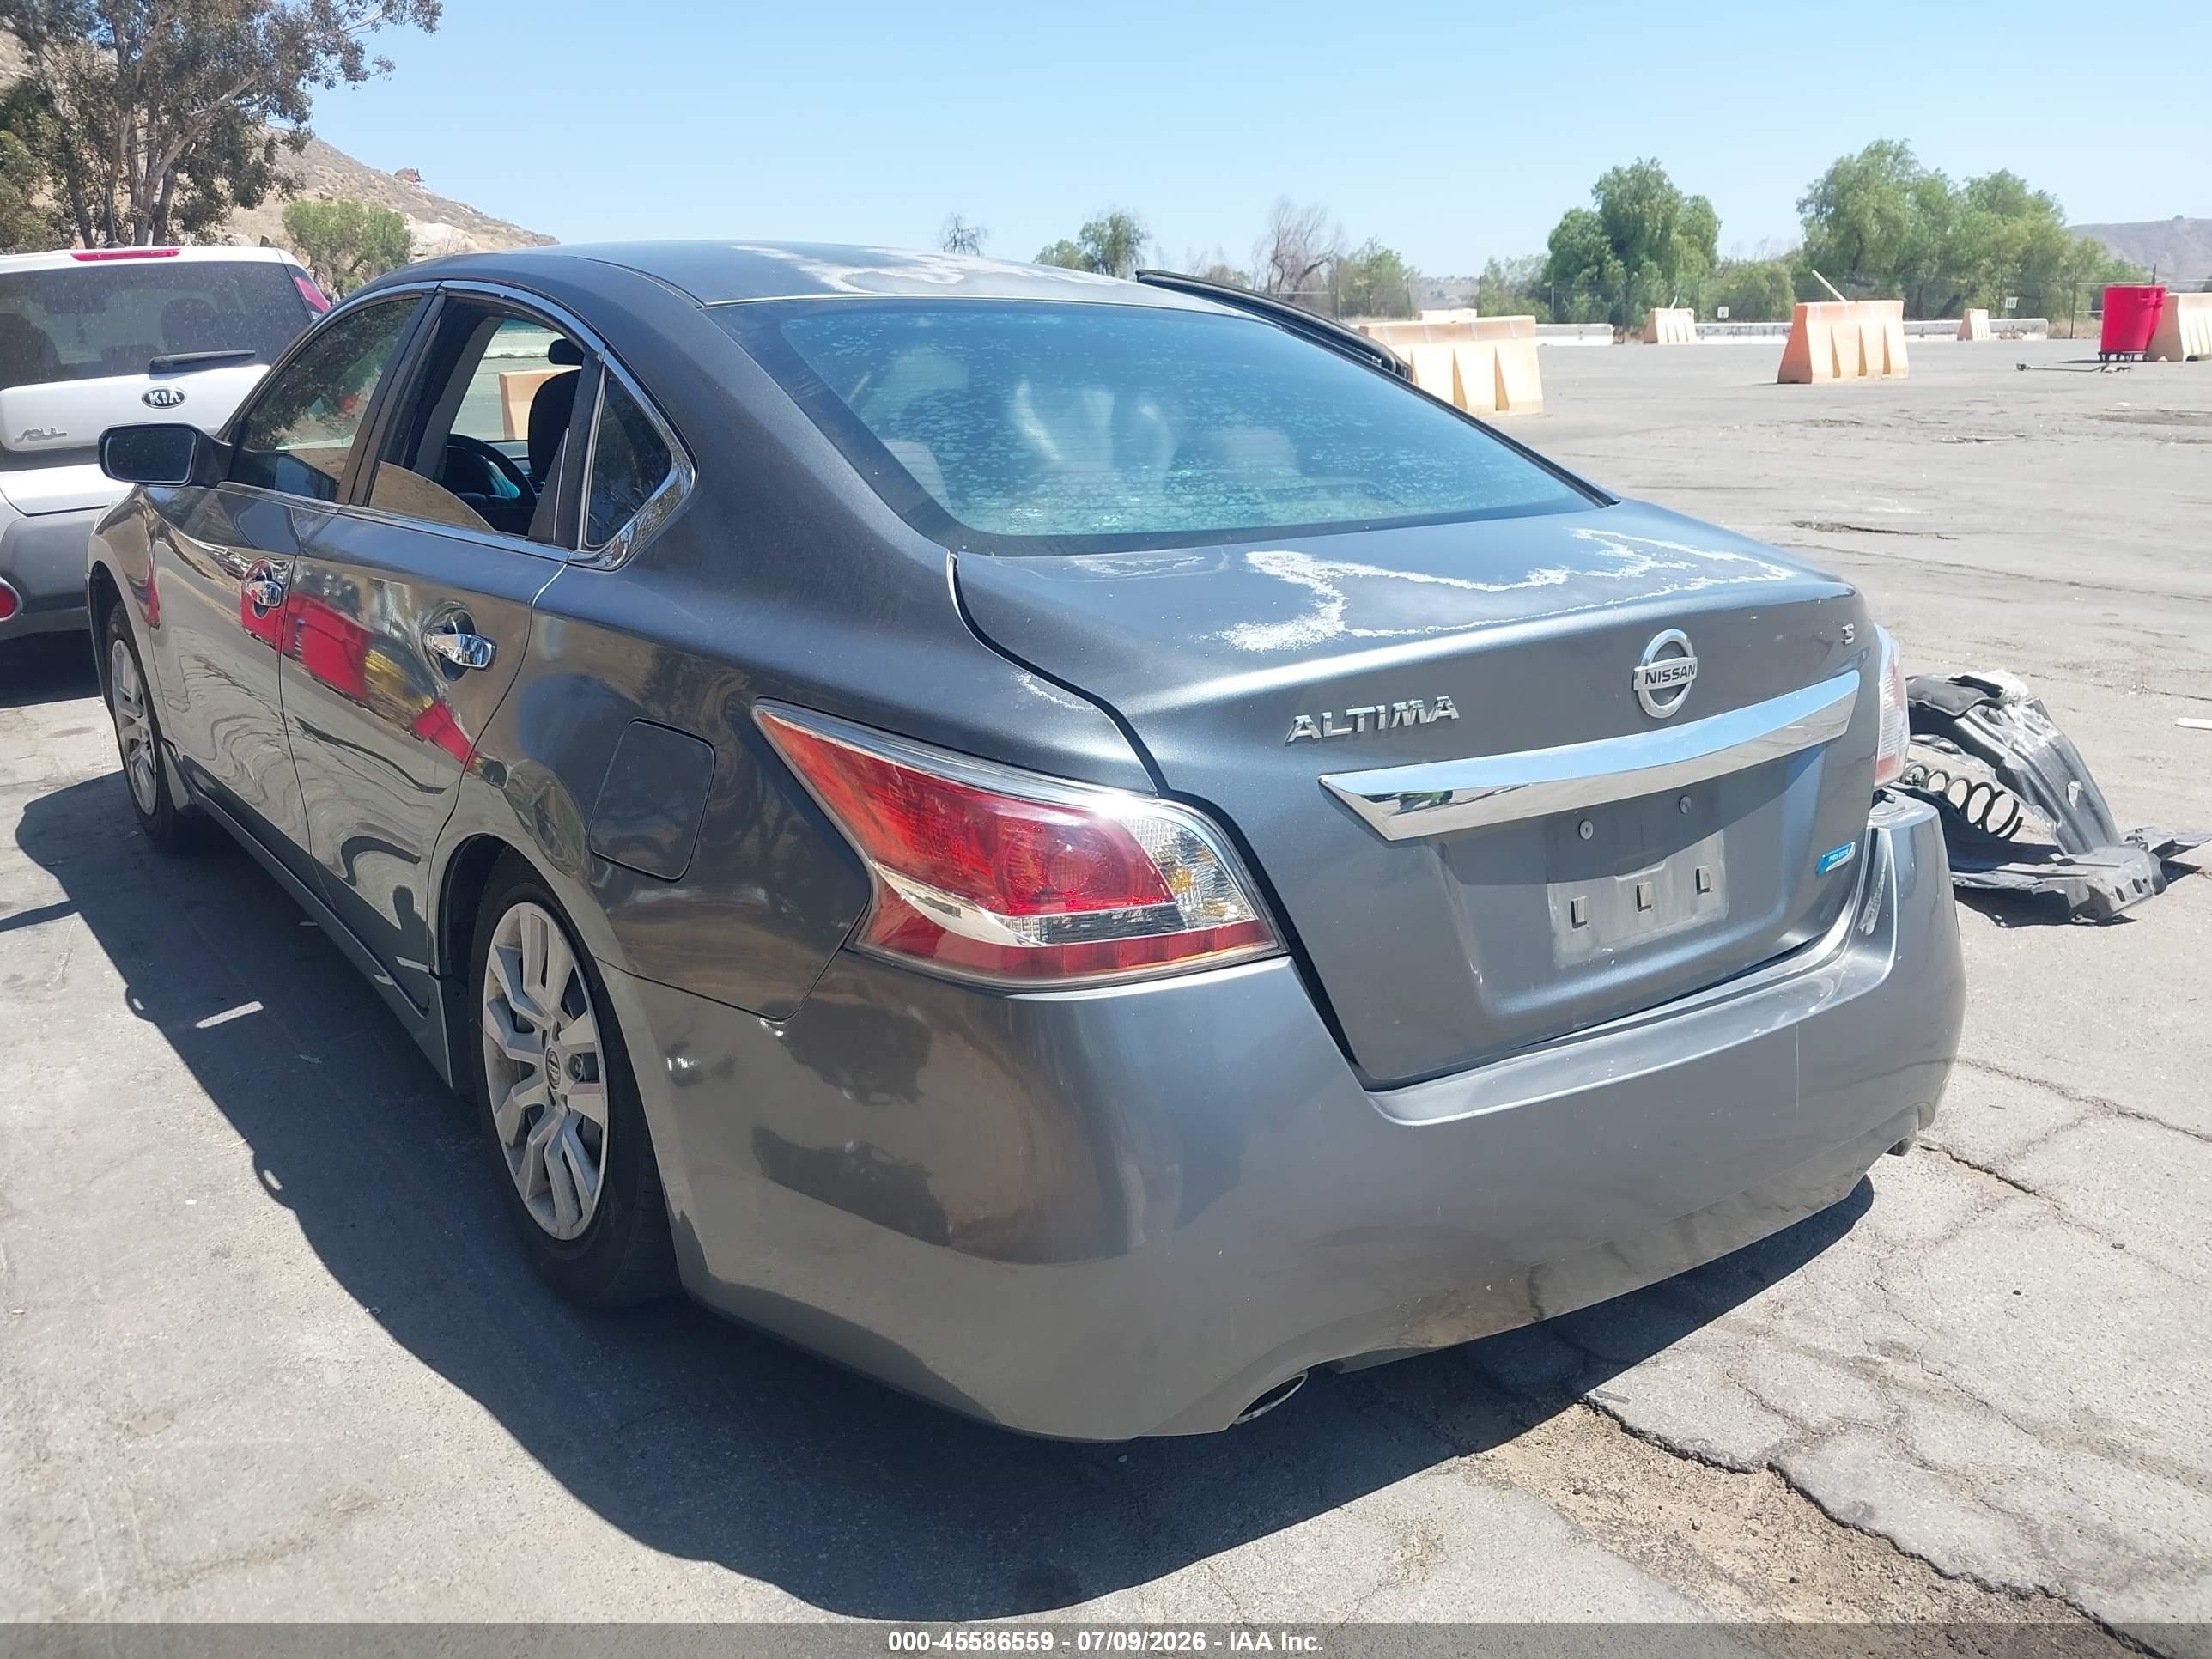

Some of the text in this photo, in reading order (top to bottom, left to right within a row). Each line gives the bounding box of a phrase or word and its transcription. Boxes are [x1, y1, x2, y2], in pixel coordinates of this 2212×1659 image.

[149, 391, 181, 404] KIA
[1841, 623, 1855, 645] S
[1644, 664, 1696, 684] NISSAN
[1285, 696, 1460, 744] ALTIMA
